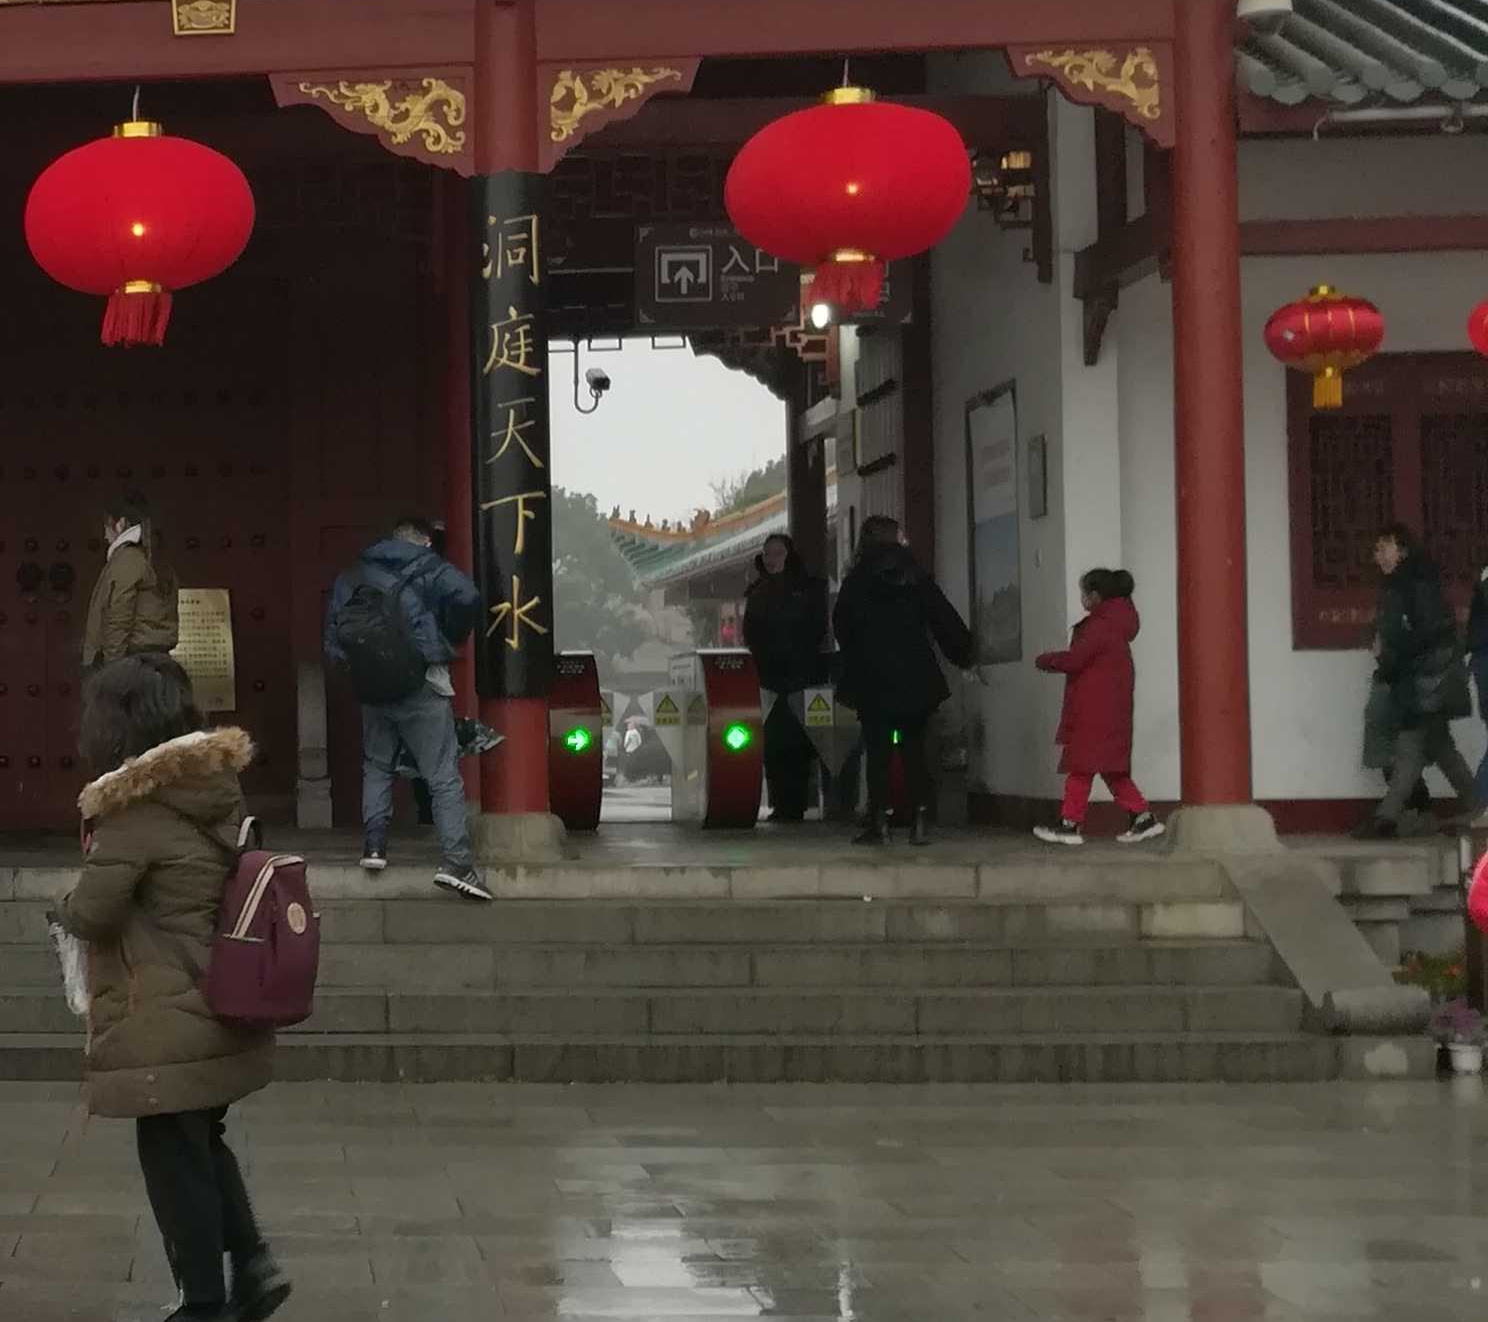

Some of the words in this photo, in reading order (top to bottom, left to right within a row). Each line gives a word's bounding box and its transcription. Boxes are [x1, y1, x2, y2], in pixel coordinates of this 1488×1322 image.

[721, 245, 779, 274] 入口
[479, 213, 549, 652] 洞庭天下水
